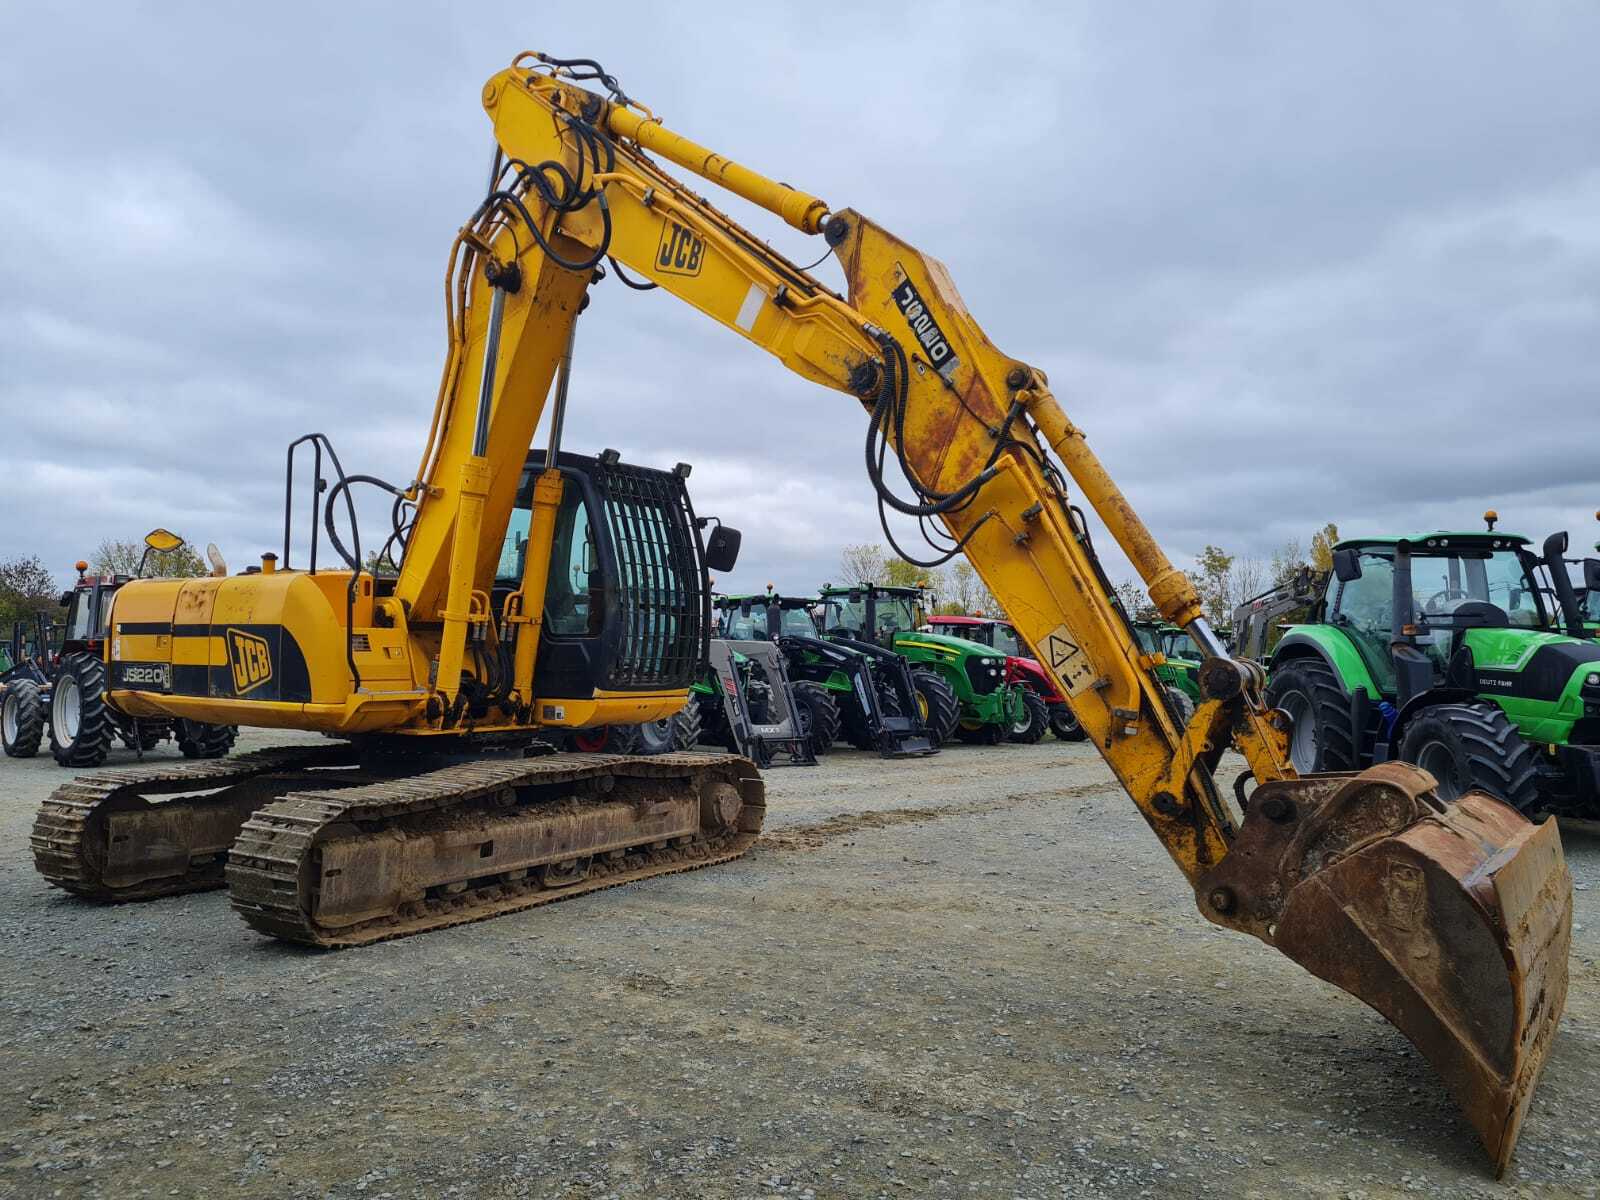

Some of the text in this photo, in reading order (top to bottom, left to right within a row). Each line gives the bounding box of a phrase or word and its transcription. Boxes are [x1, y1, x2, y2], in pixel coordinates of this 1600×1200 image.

[659, 223, 702, 270] JCB
[122, 667, 164, 683] JS220
[234, 635, 270, 687] JCB
